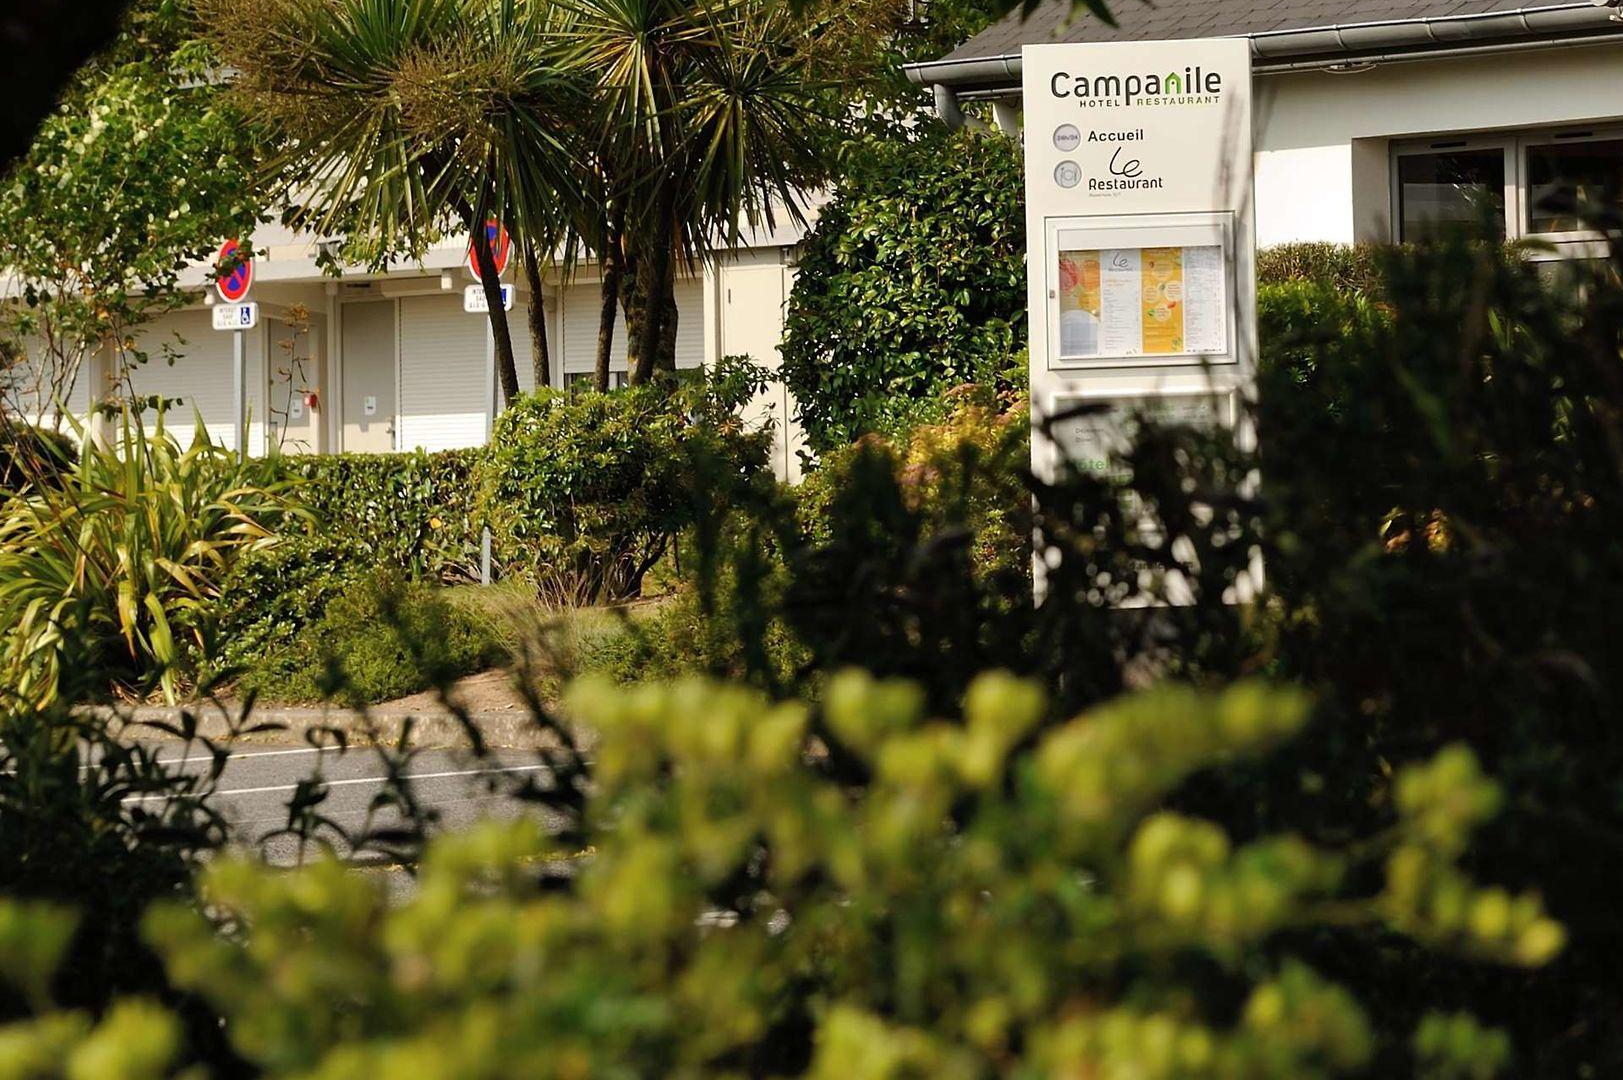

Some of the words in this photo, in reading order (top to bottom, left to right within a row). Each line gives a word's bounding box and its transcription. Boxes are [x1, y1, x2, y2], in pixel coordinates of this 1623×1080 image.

[1051, 67, 1221, 106] Campanile
[1079, 100, 1120, 108] HOTEL
[1137, 96, 1220, 106] RESTAURANT
[1088, 129, 1144, 142] Accueil
[1109, 146, 1143, 178] Le
[1088, 177, 1163, 191] Restaurant
